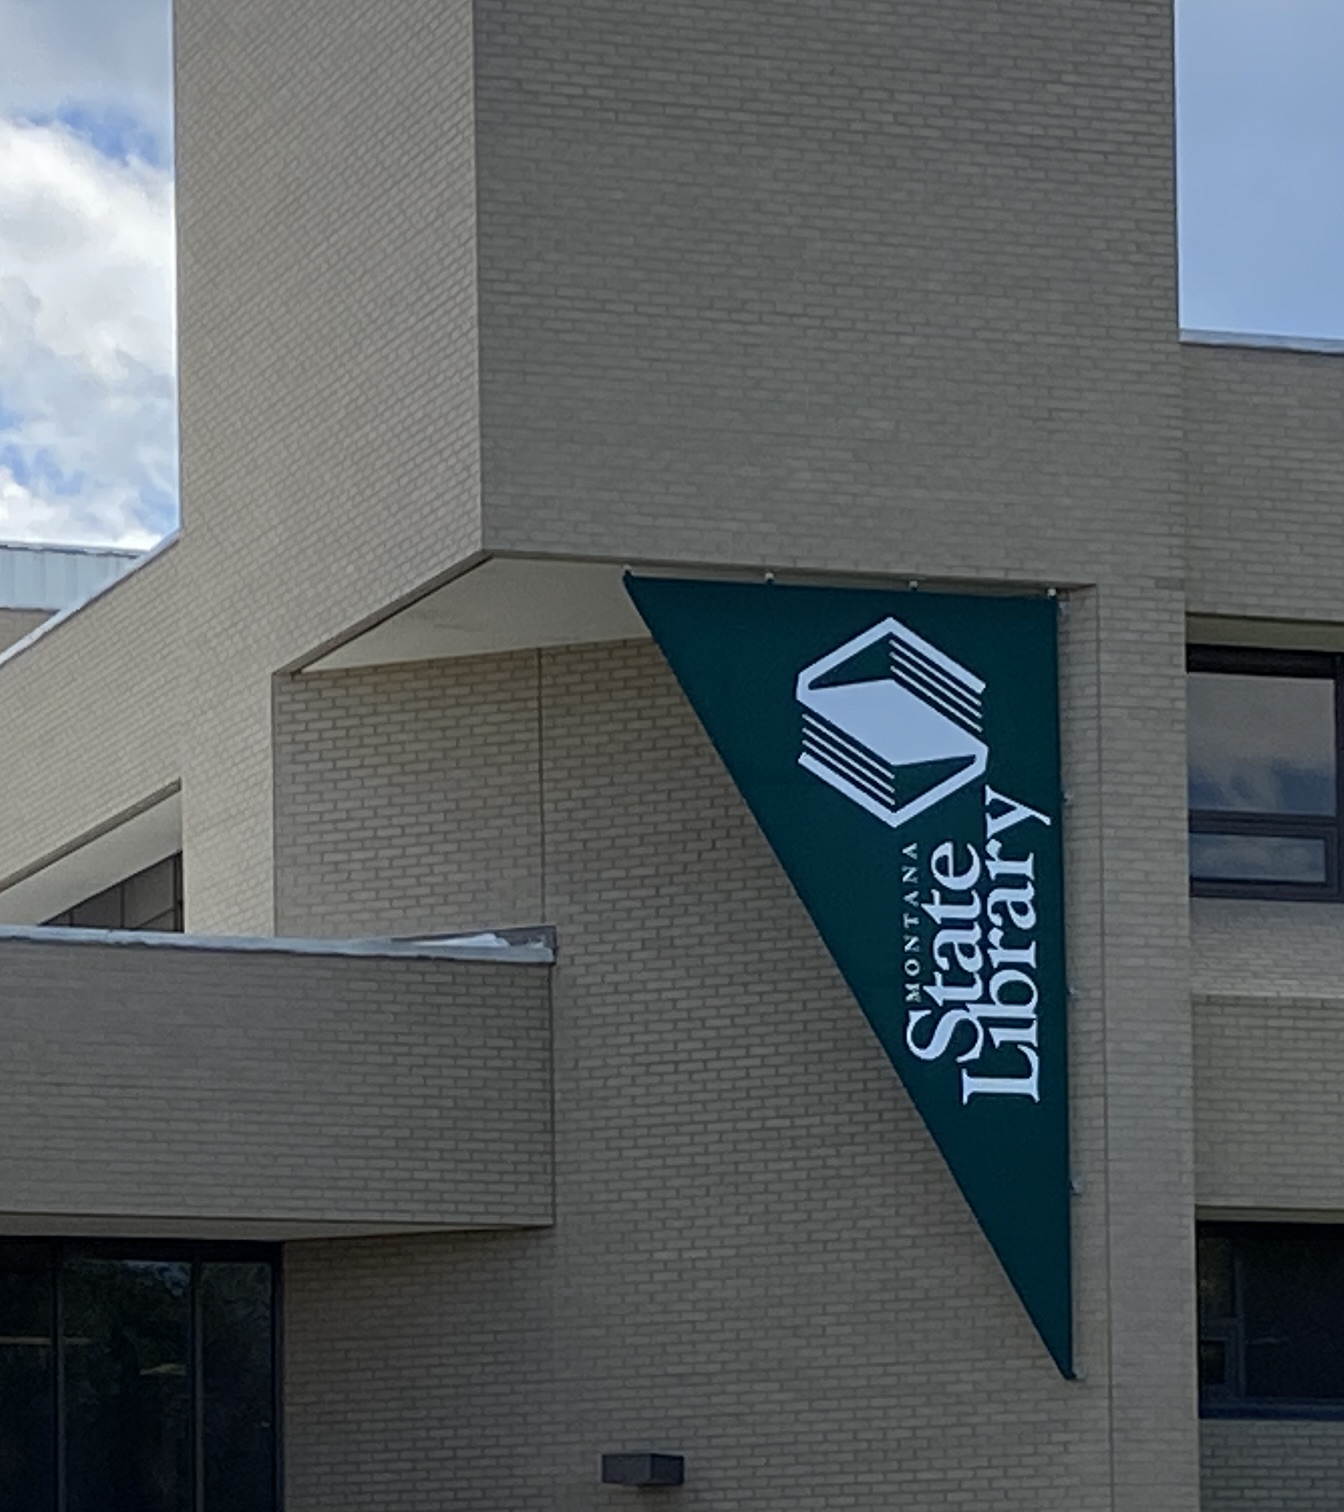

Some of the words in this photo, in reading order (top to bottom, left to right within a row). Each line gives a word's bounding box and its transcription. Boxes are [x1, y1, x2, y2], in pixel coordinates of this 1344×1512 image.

[902, 842, 922, 1003] MONTANA
[906, 841, 985, 1063] State
[959, 784, 1052, 1105] Library
